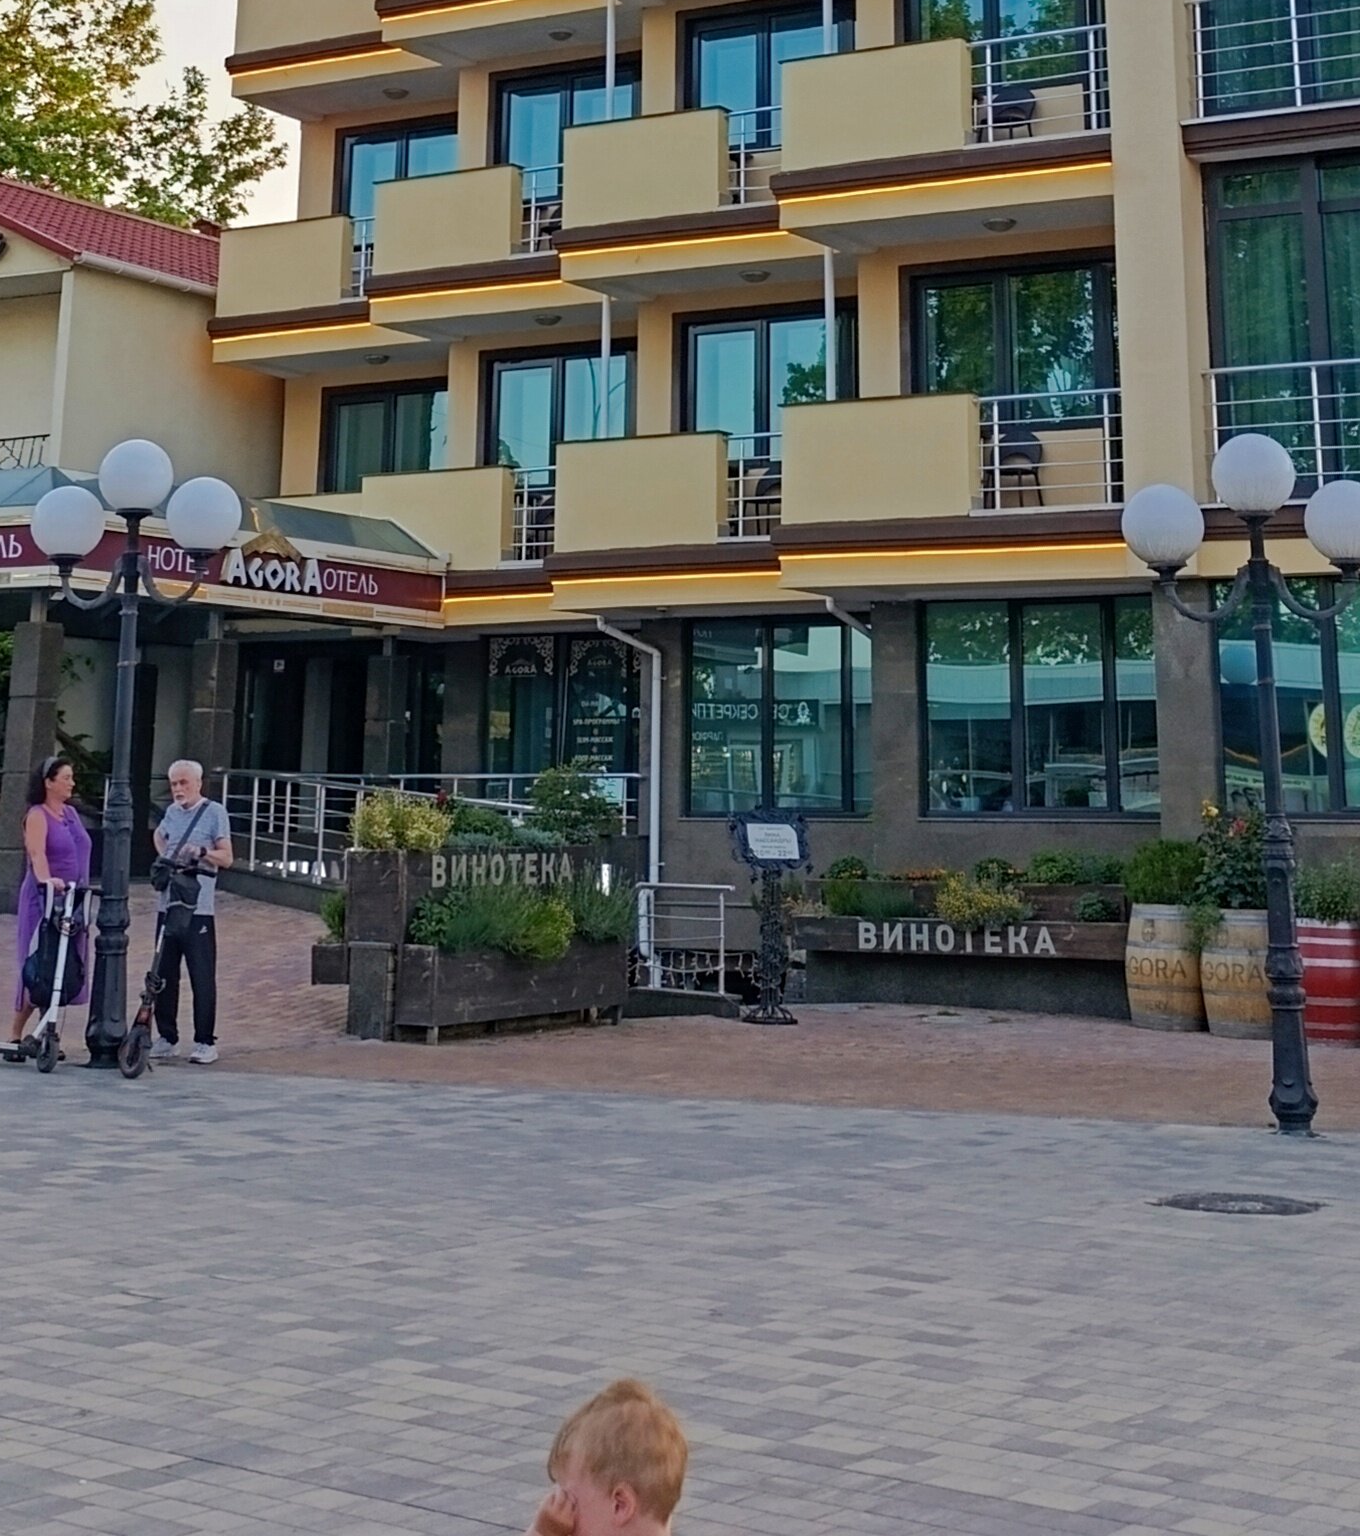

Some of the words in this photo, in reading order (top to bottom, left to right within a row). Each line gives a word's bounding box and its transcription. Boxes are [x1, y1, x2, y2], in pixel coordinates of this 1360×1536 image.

[147, 545, 209, 575] HOTE
[227, 548, 322, 594] AGORA
[323, 568, 378, 595] ОТЕЛЬ
[505, 664, 537, 674] AGORA
[431, 853, 573, 888] ВИНОТЕКА
